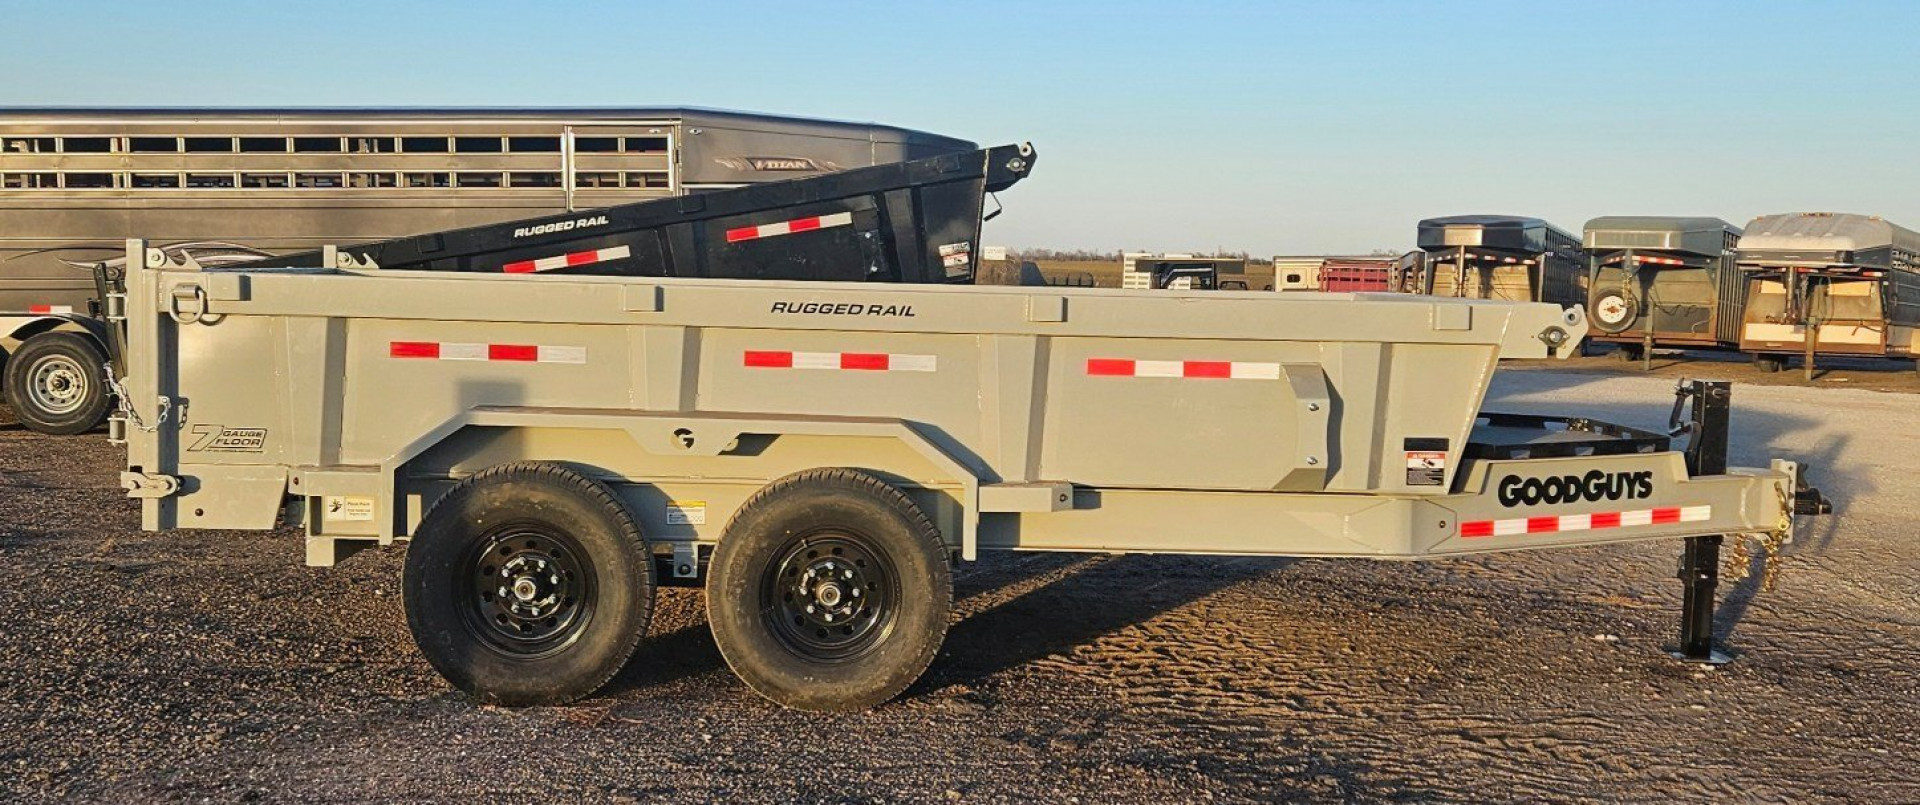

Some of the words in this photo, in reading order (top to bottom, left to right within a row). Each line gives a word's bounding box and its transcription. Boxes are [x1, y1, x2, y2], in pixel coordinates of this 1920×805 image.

[514, 220, 575, 238] RUGGED
[575, 215, 609, 229] RAIL
[771, 301, 864, 315] RUGGED
[867, 304, 916, 317] RAIL
[186, 423, 225, 452] 7
[215, 438, 261, 446] FLOOR
[1498, 469, 1653, 508] GOODGUYS
